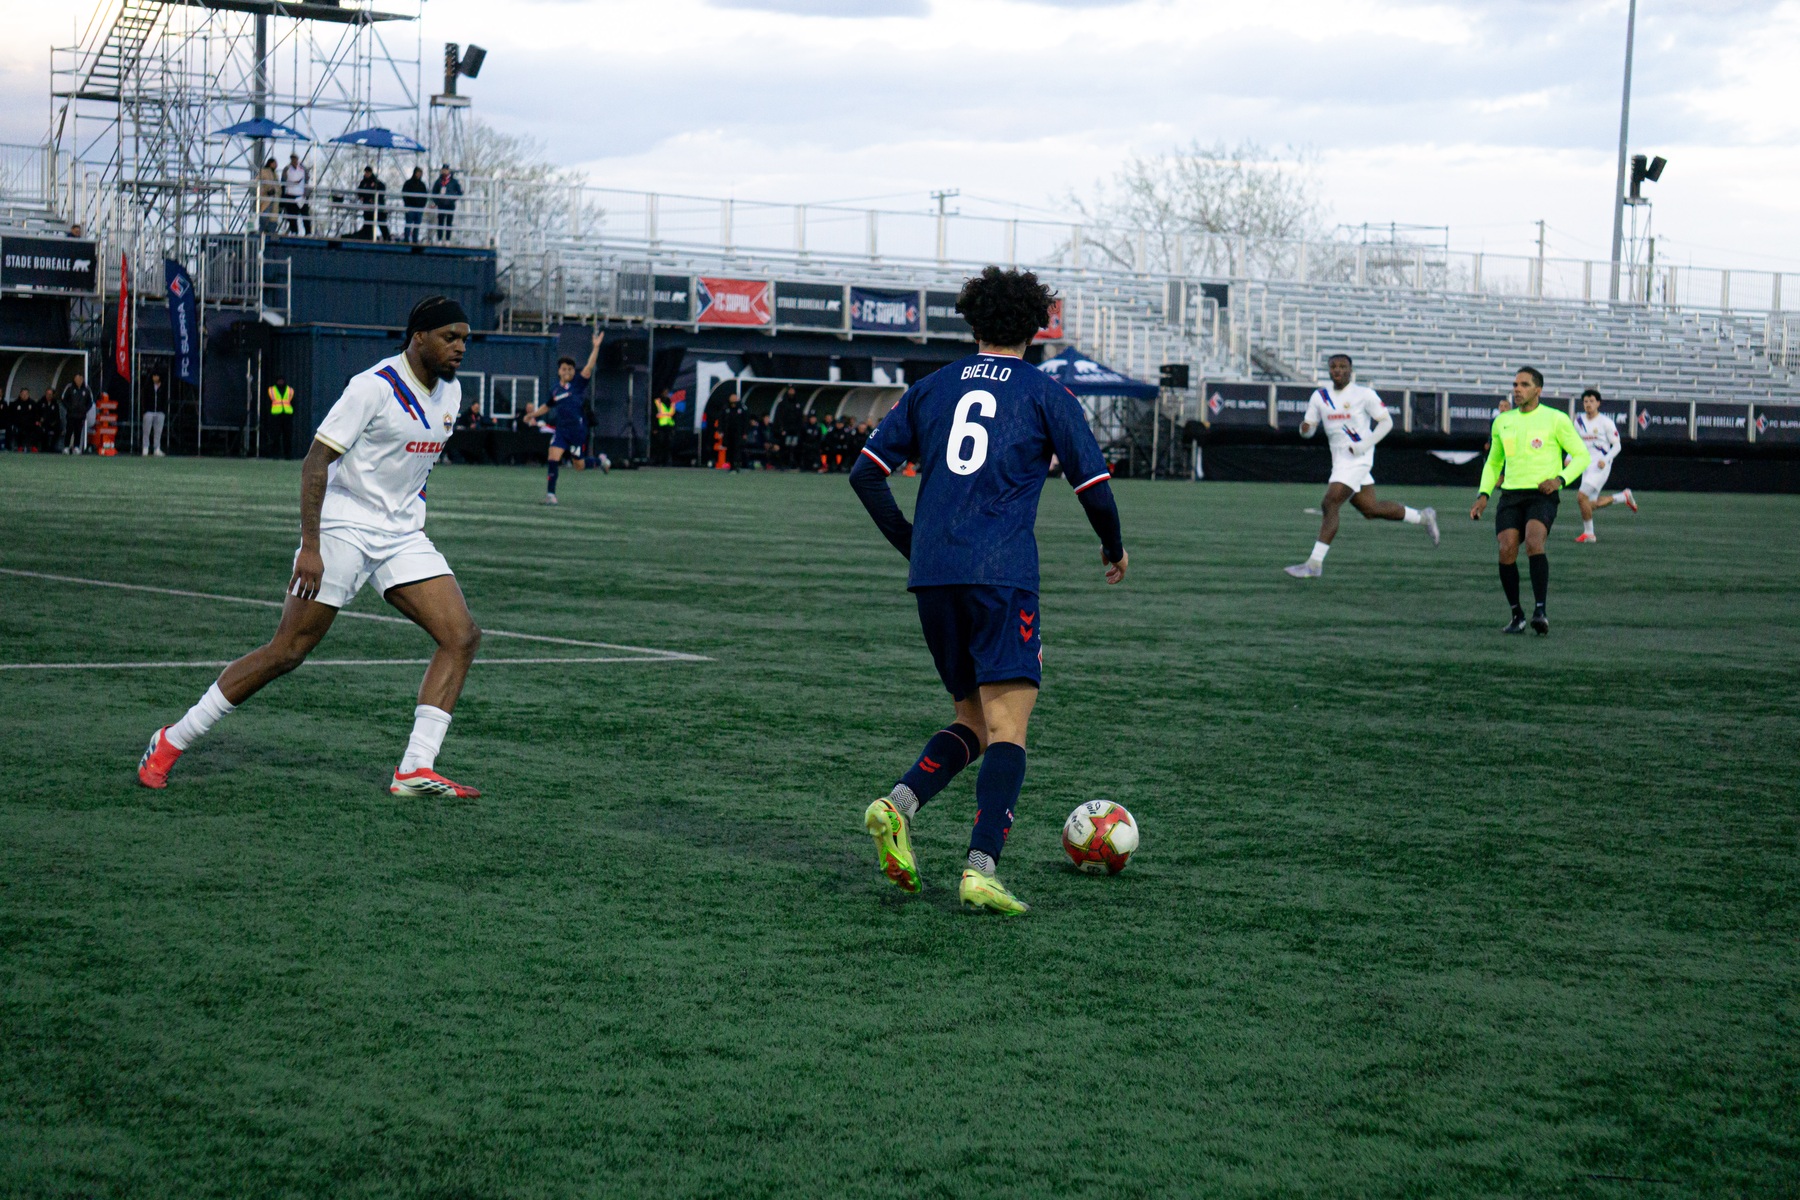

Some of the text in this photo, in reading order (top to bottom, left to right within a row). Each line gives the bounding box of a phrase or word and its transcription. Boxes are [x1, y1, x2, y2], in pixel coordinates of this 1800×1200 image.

[5, 254, 71, 272] STADE BOREALE
[862, 299, 876, 323] FC
[177, 302, 190, 378] FC SUPRA
[960, 363, 1012, 382] BIELLO
[1652, 415, 1688, 426] FC SUPRA
[1713, 415, 1735, 428] BOREALE
[1769, 420, 1779, 429] FC
[946, 389, 997, 476] 6
